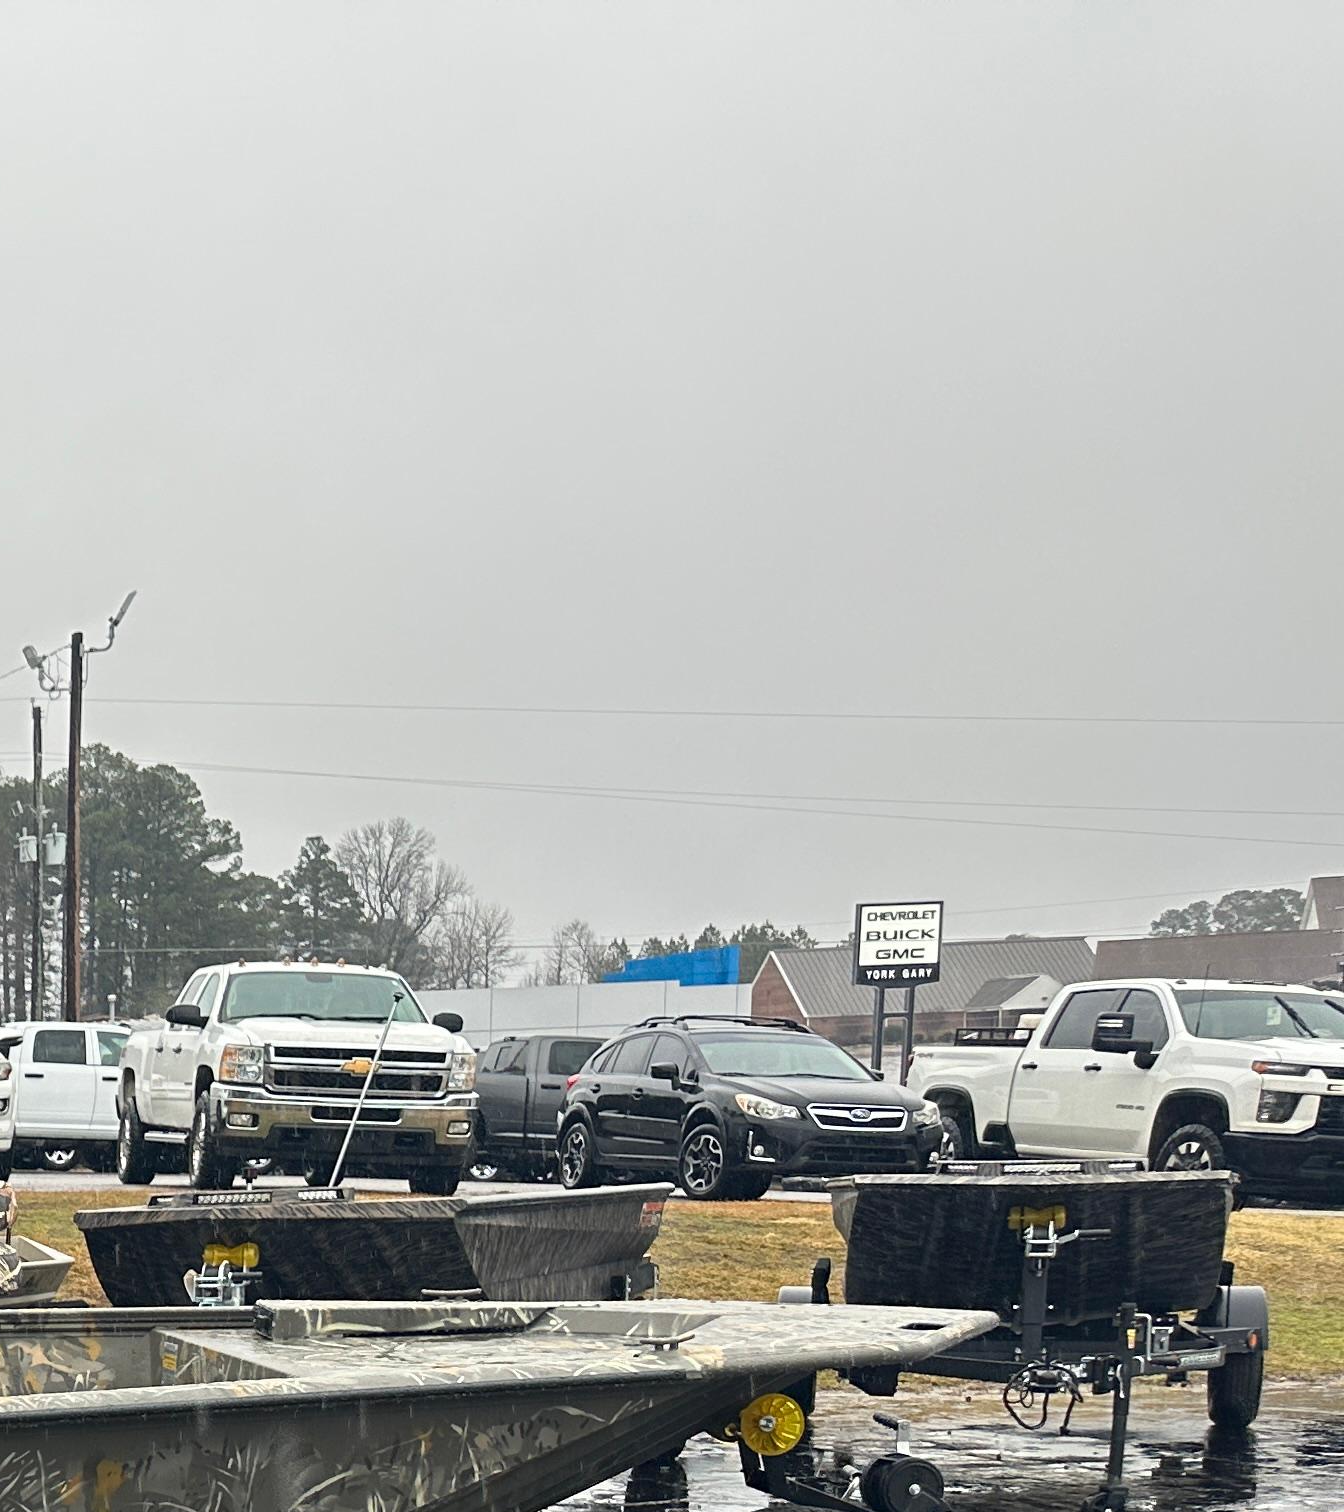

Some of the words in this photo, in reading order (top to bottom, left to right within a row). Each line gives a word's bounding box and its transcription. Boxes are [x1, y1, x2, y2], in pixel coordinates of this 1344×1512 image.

[867, 910, 937, 922] CHEVROLET
[866, 929, 936, 942] BUICK
[875, 948, 925, 960] GMC
[866, 969, 896, 980] YORK
[901, 968, 932, 979] GARY
